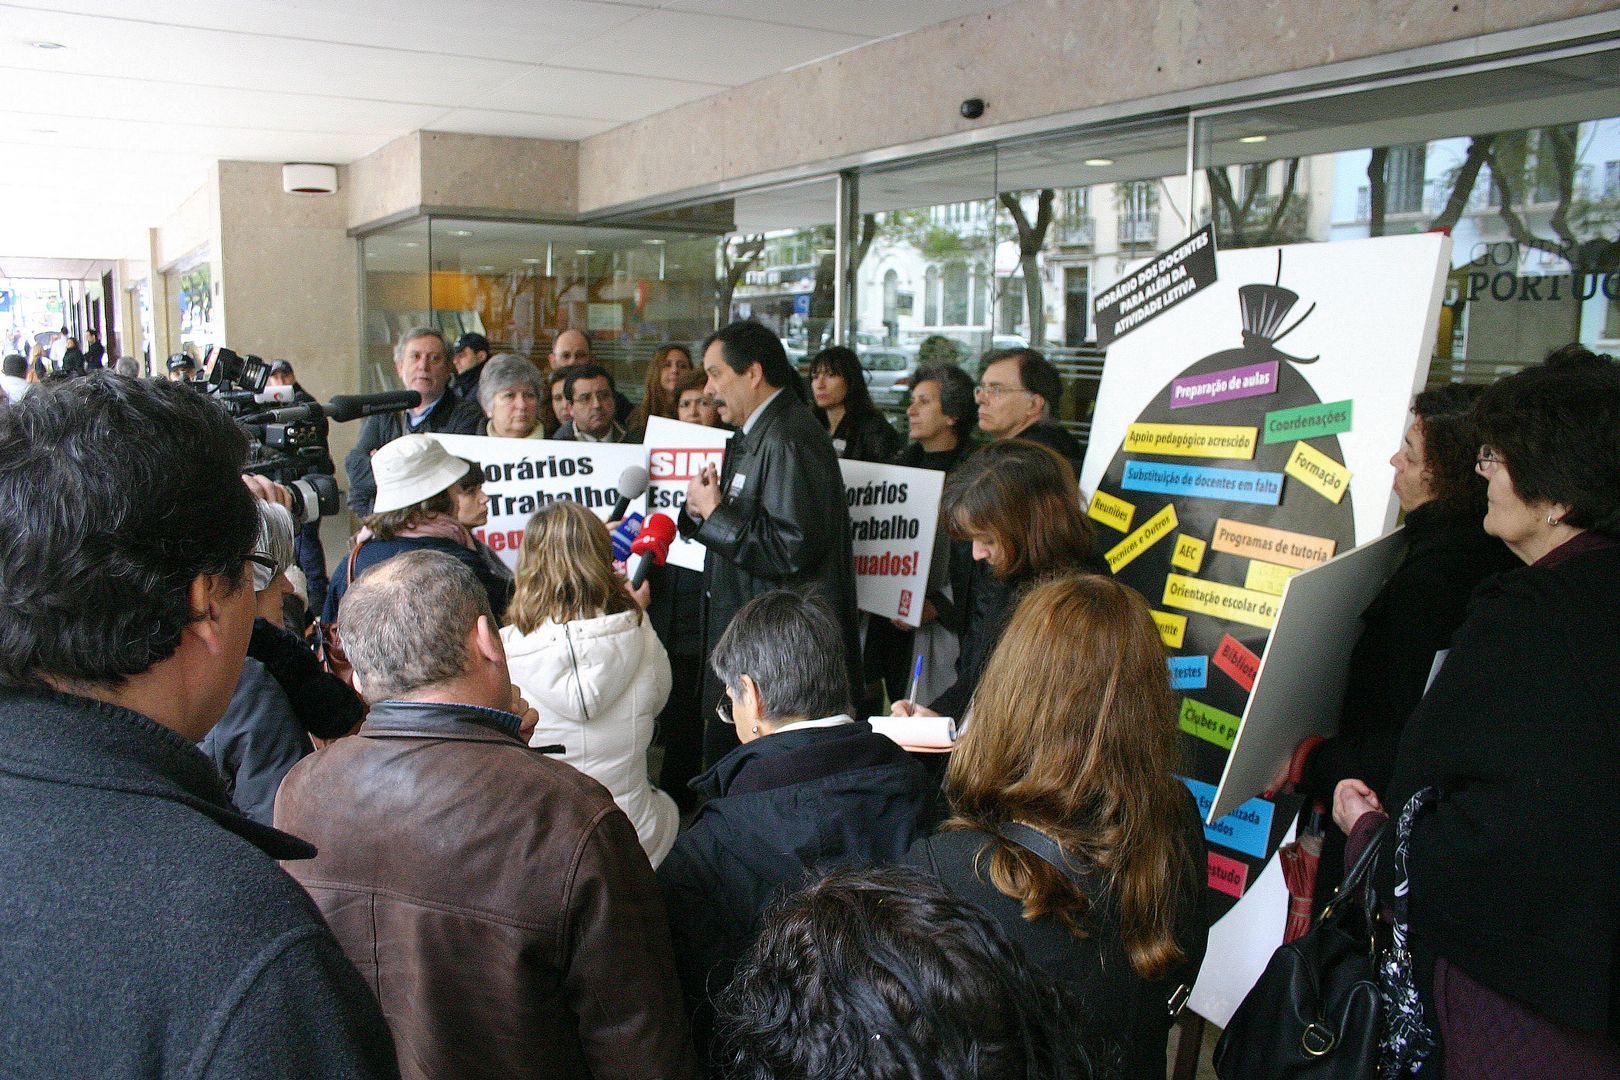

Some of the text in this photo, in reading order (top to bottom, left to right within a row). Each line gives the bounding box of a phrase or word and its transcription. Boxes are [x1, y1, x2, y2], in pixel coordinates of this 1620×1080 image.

[1096, 231, 1209, 312] HORÁRIO DOS DOCENTES
[1120, 264, 1187, 315] PARA ALÉM DA
[1114, 277, 1197, 335] ATIVIDADE LETIVA
[1175, 371, 1270, 400] Preparação de aulas
[1269, 409, 1347, 433] Coordenações
[1129, 430, 1251, 449] Apoio pedagógico acrescido
[484, 455, 594, 483] orários
[651, 452, 723, 477] SIM
[1294, 451, 1342, 490] Formação
[847, 480, 908, 507] orários
[1128, 467, 1278, 494] Substituição de docentes em falta
[648, 486, 686, 508] Esc
[852, 515, 919, 541] rabalho
[1144, 515, 1171, 539] Outros
[1179, 544, 1198, 560] AEC
[1218, 527, 1328, 563] Programas de tutoria
[855, 551, 919, 576] uados!
[1170, 583, 1220, 607] Orientação
[1222, 593, 1259, 614] escolar
[1258, 601, 1273, 616] de
